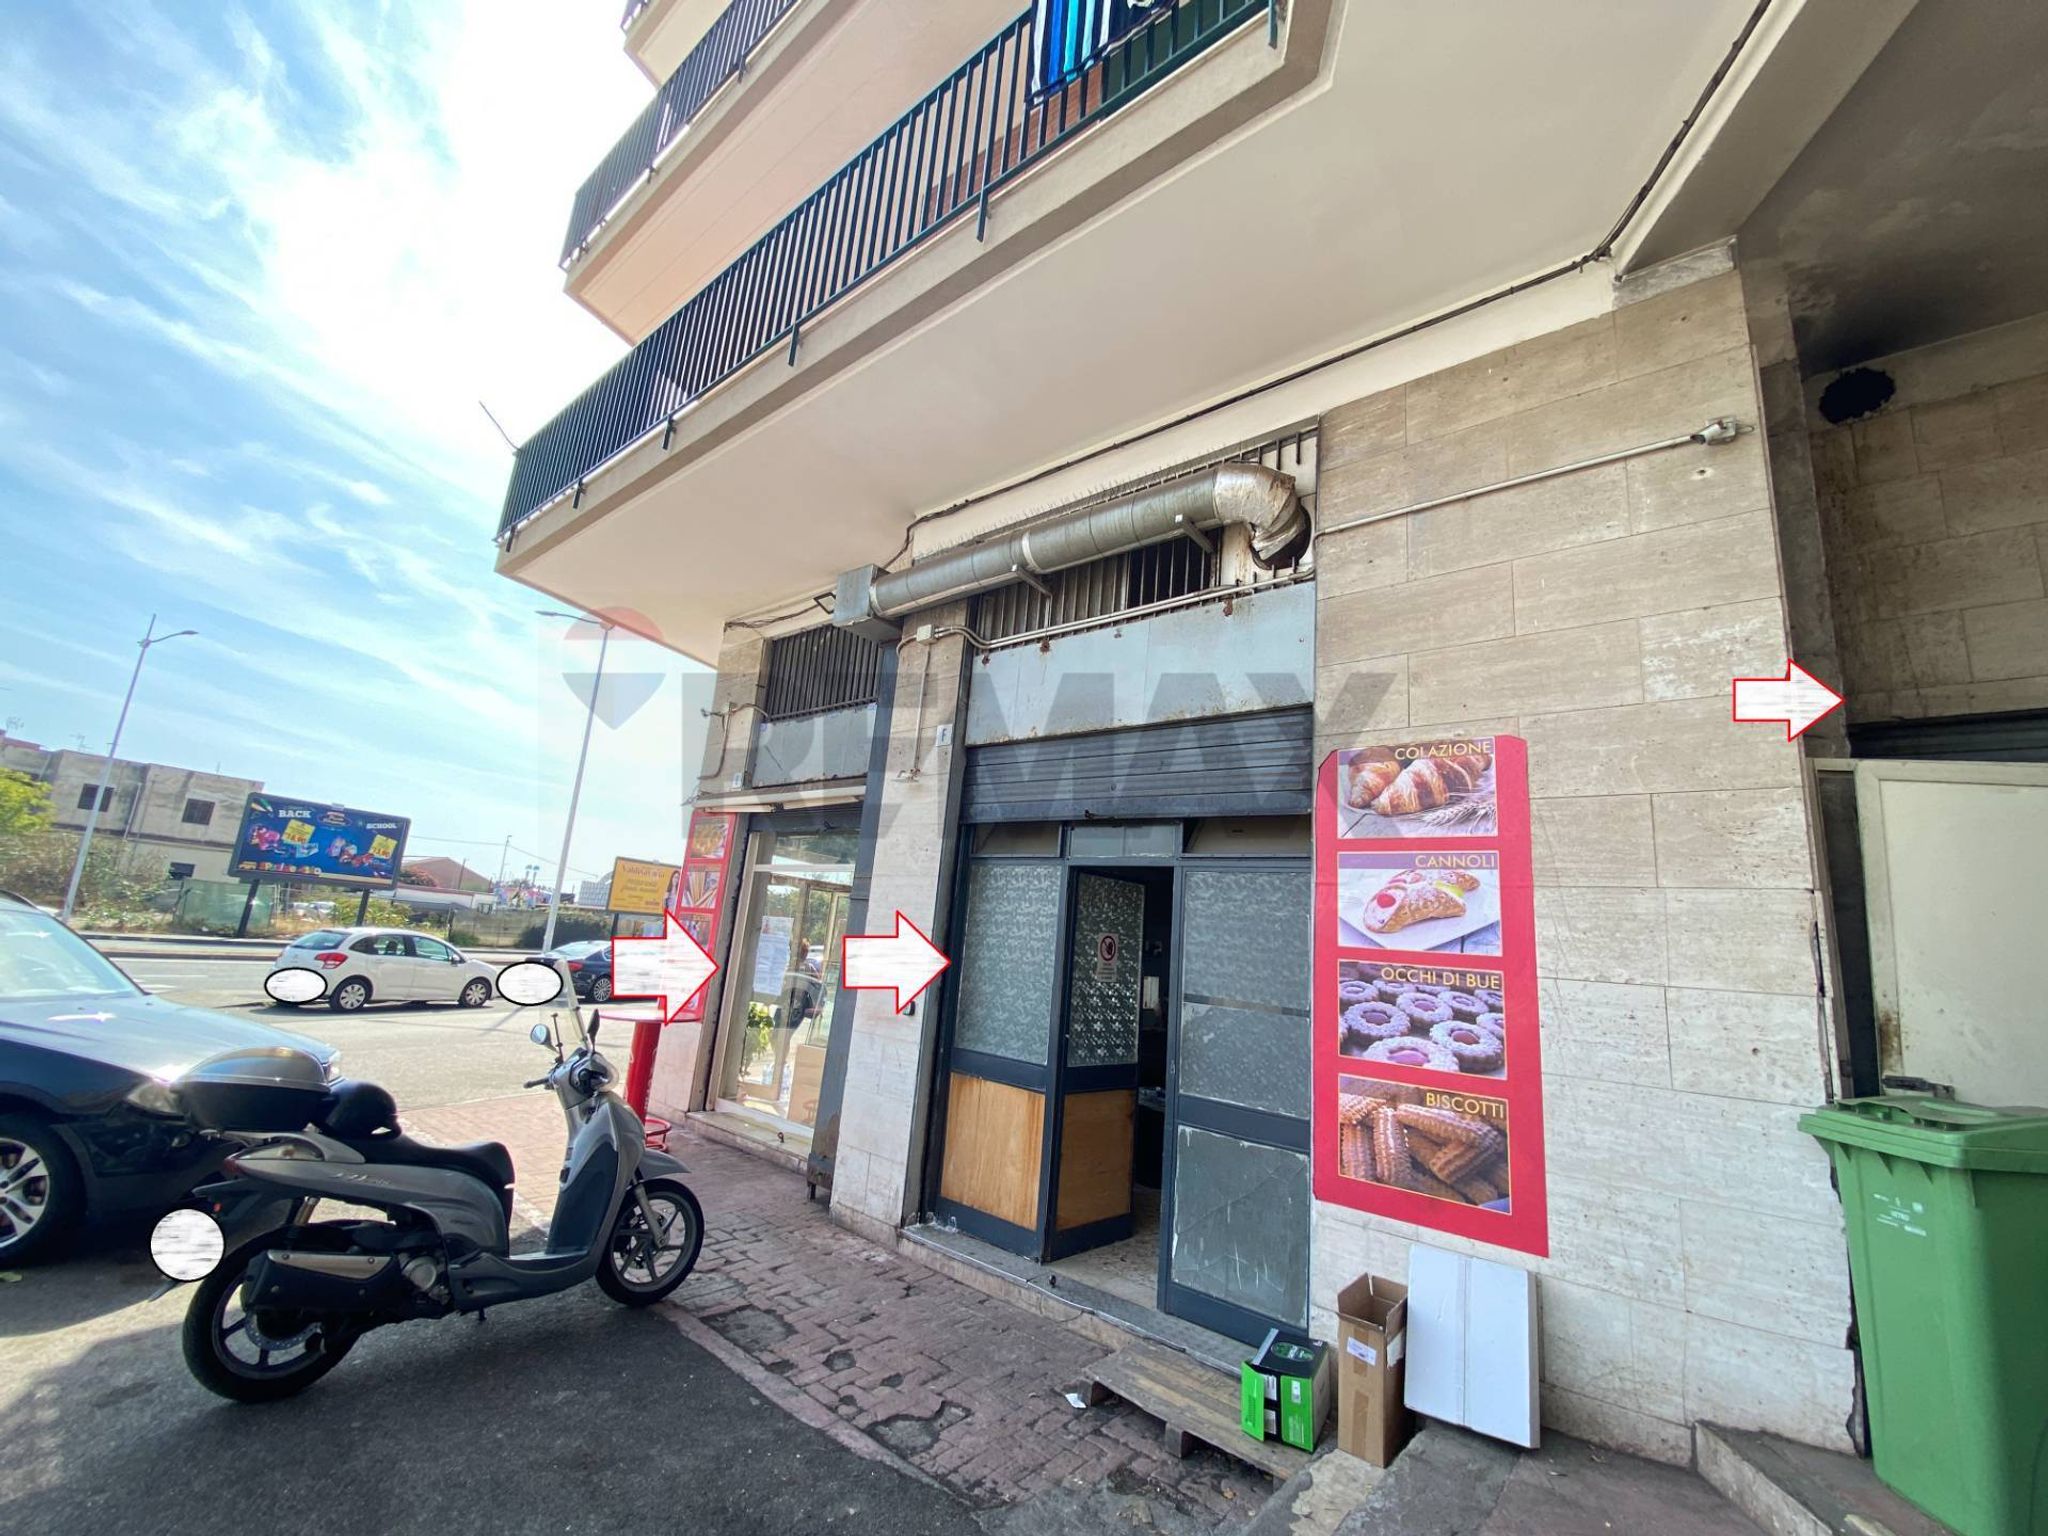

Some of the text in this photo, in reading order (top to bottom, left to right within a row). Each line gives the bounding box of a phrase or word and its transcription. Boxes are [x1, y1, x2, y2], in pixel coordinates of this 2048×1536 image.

[1395, 742, 1491, 760] COLAZIONE
[278, 809, 312, 818] BACK
[1416, 854, 1494, 868] CANNOLI
[1381, 967, 1500, 990] OCCHI DI BUE
[1426, 1092, 1504, 1118] BISCOTTI
